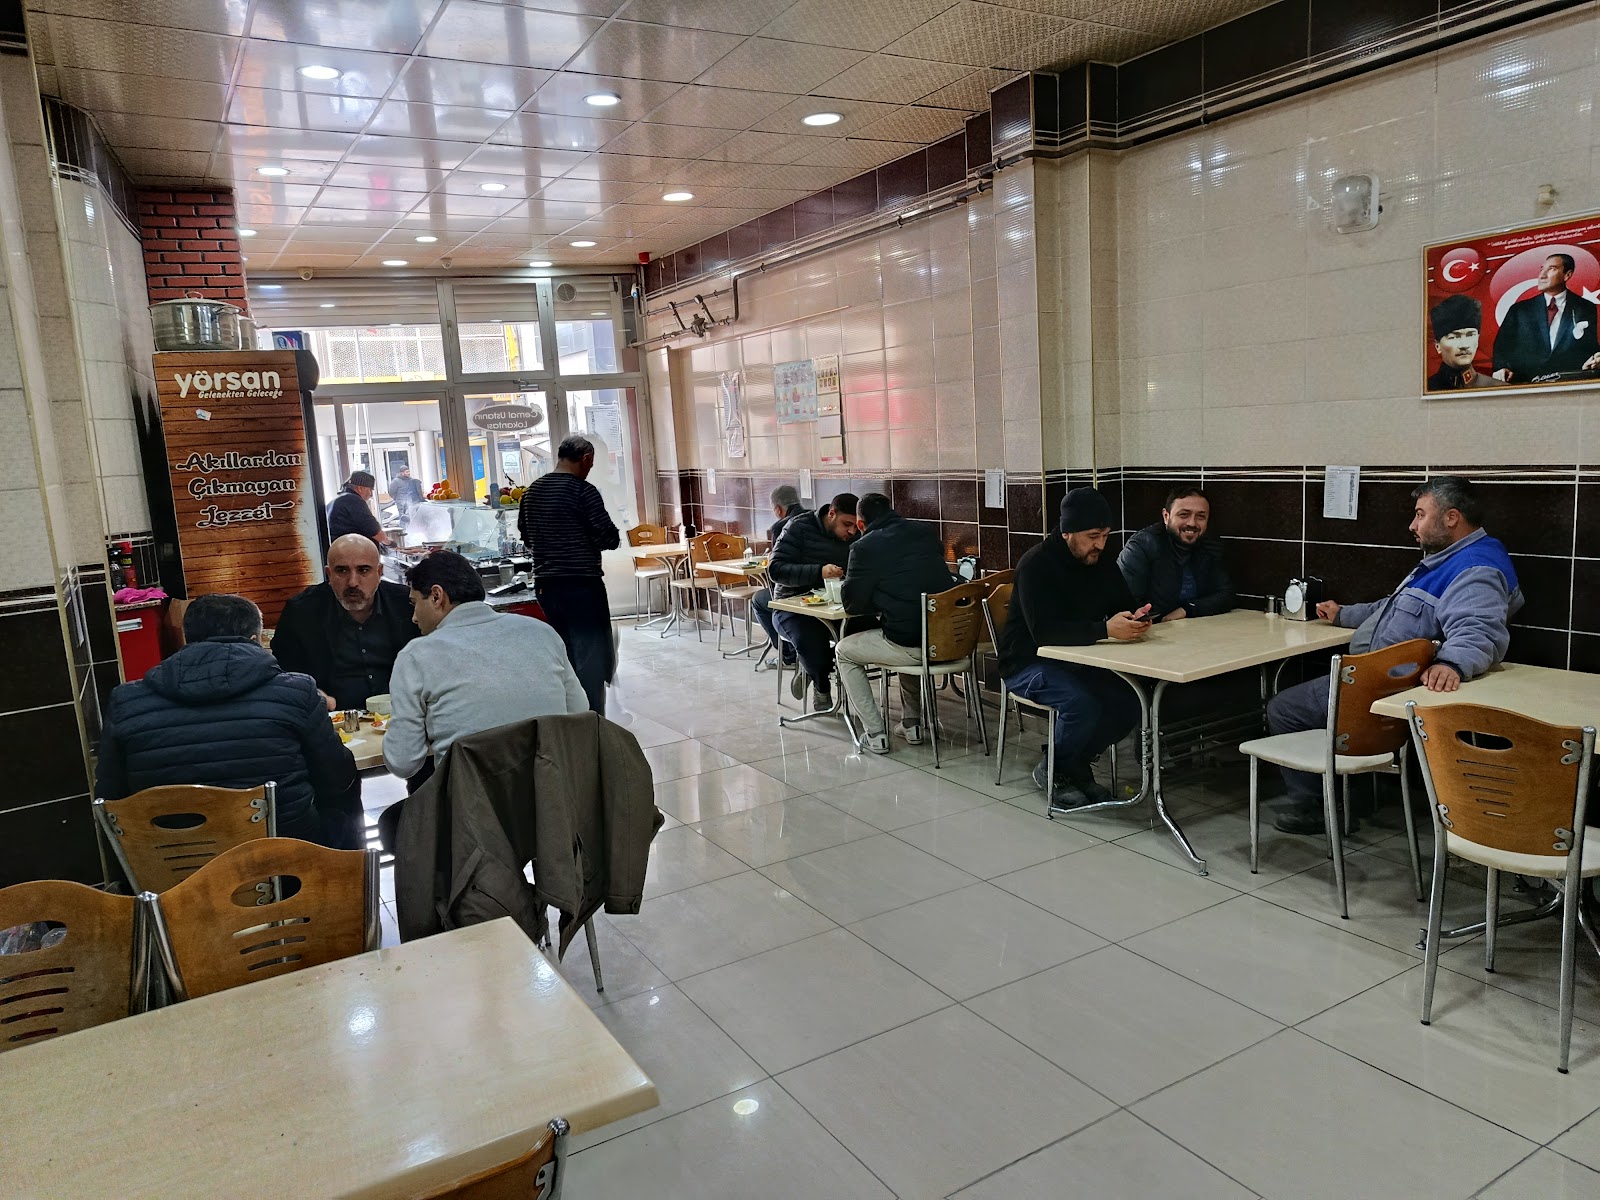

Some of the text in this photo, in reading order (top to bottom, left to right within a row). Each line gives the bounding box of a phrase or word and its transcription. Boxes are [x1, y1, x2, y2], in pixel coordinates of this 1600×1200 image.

[174, 370, 281, 398] yörsan
[198, 388, 283, 399] Gelenekten Geleceğe
[175, 450, 301, 473] Akıllardan
[188, 477, 296, 500] Çıkmayan
[196, 501, 294, 528] Lezzet
